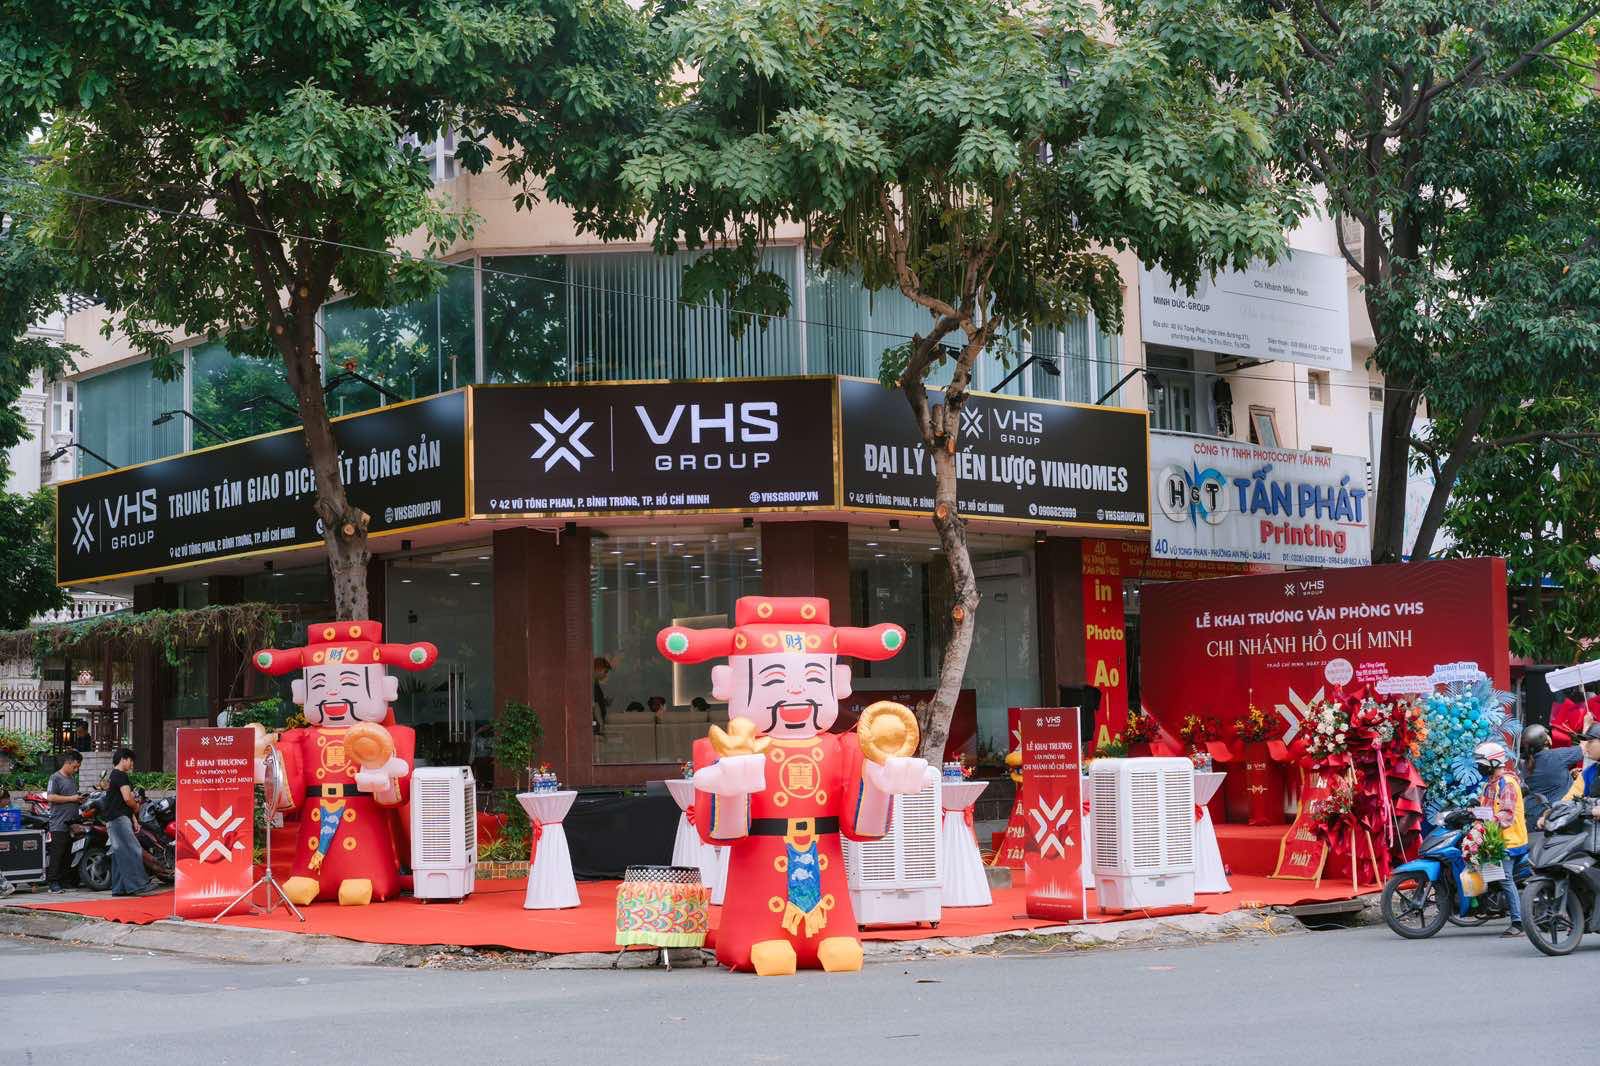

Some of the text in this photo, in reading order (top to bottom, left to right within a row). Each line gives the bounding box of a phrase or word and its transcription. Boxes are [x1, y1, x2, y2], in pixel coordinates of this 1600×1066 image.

[634, 401, 779, 445] VHS
[993, 408, 1043, 434] VHS
[1000, 433, 1041, 445] GROUP
[655, 452, 771, 471] GROUP
[1194, 442, 1219, 456] CÔNG
[1220, 446, 1230, 457] TY
[1232, 447, 1251, 460] TNHH
[1253, 450, 1298, 464] PHOTOCOPY
[168, 487, 210, 519] TRUNG
[214, 478, 242, 510] TÂM
[247, 472, 280, 503] GIAO
[358, 447, 401, 486] ĐỘNG
[408, 433, 441, 473] SẢN
[864, 443, 898, 479] ĐẠI
[904, 442, 925, 476] LÝ
[991, 454, 1036, 490] LƯỢC
[1041, 460, 1129, 493] VINHOMES
[499, 499, 510, 510] 42
[511, 497, 523, 509] VŨ
[549, 498, 575, 509] PHAN,
[577, 497, 585, 508] P.
[586, 495, 607, 508] BÌNH
[642, 496, 654, 506] TP.
[670, 493, 685, 505] CHÍ
[686, 494, 710, 505] MINH
[761, 490, 819, 503] VHSGROUP.VN
[856, 493, 865, 504] 42
[1233, 463, 1366, 523] TẤN PHÁT
[104, 488, 157, 529] VHS
[394, 499, 441, 521] VHSGROUP.VN
[111, 530, 154, 550] GROUP
[1155, 538, 1168, 555] 40
[1259, 519, 1347, 554] Printing
[1095, 579, 1112, 601] in
[1299, 580, 1325, 591] VHS
[1196, 602, 1425, 629] LỄ KHAI TRƯƠNG VĂN PHÒNG VHS
[1086, 624, 1124, 641] Photo
[1206, 628, 1413, 658] CHI NHÁNH HỒ CHÍ MINH
[1045, 715, 1061, 724] VHS
[213, 735, 234, 743] VHS
[196, 759, 215, 767] KHAI
